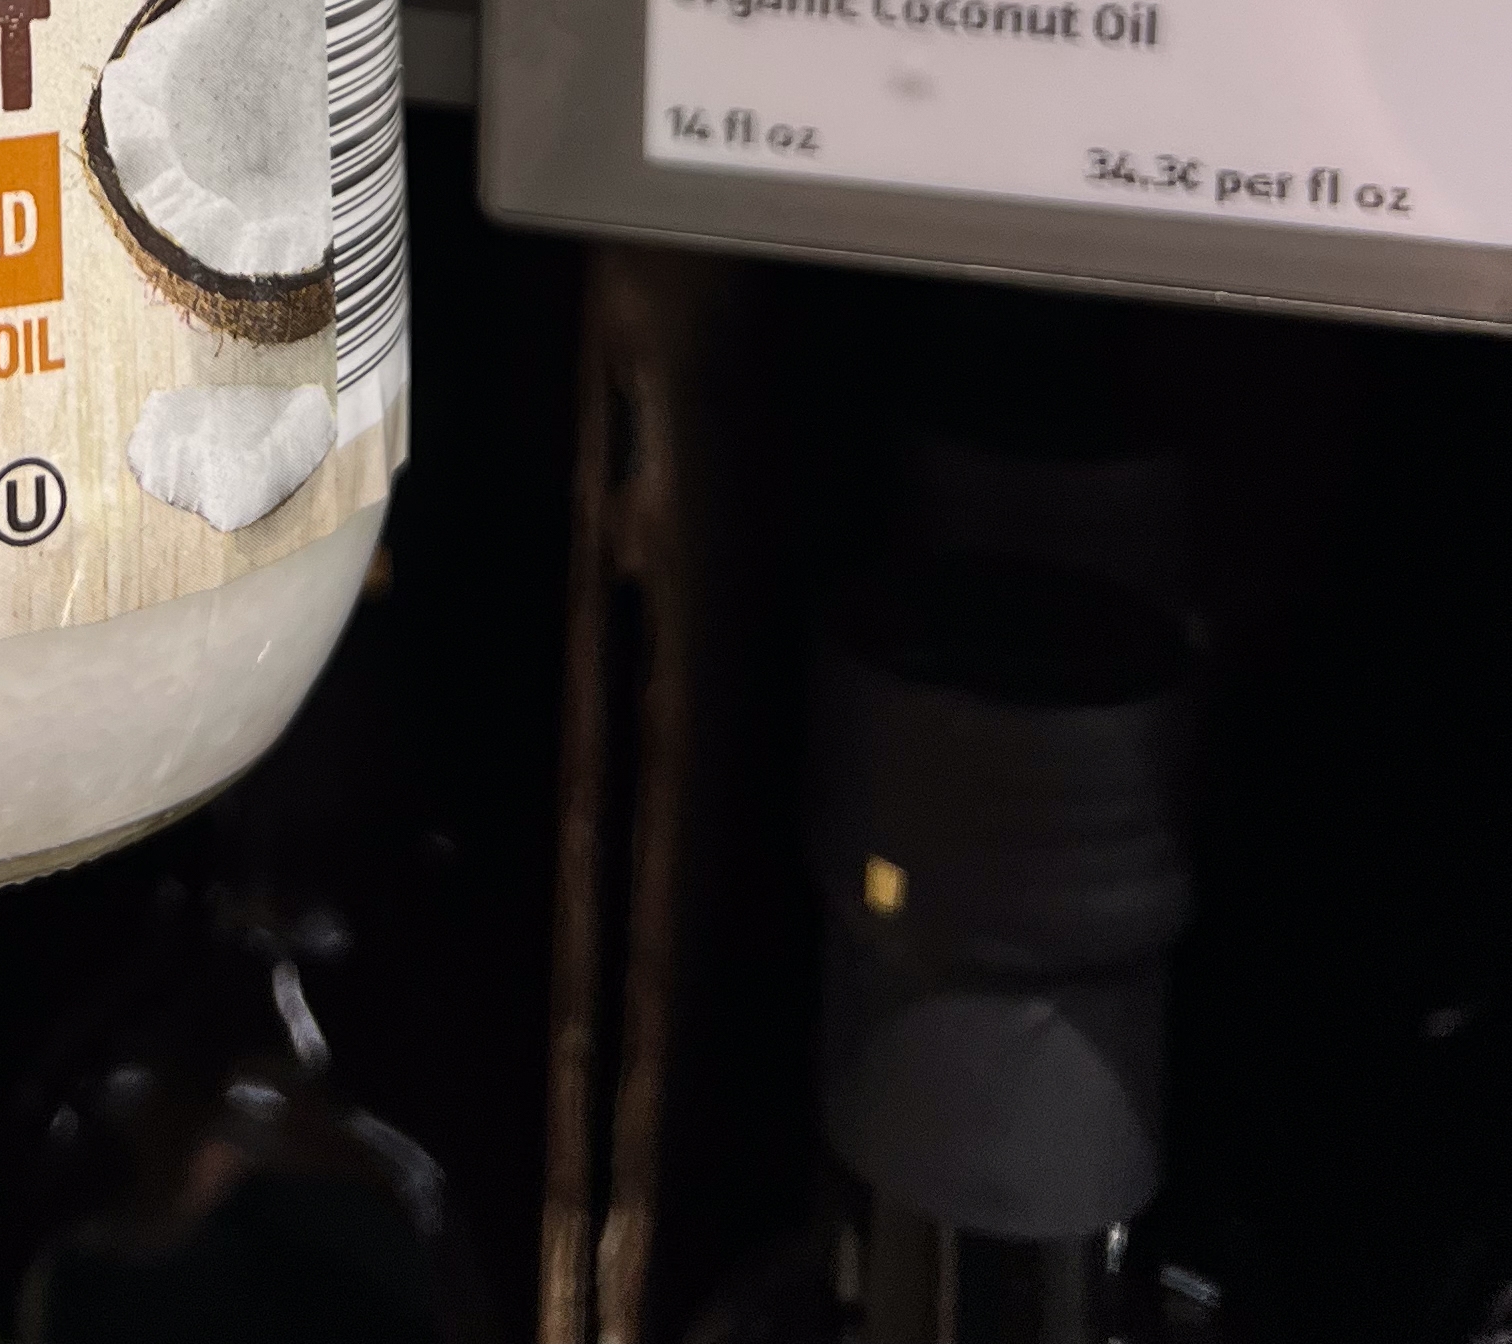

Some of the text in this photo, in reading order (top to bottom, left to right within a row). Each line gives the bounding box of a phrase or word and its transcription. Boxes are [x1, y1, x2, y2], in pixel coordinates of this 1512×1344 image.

[1092, 1, 1161, 46] Oil
[666, 105, 822, 155] 14 fl oz
[1214, 168, 1294, 203] per
[1308, 166, 1342, 205] fl
[1355, 182, 1413, 212] oz
